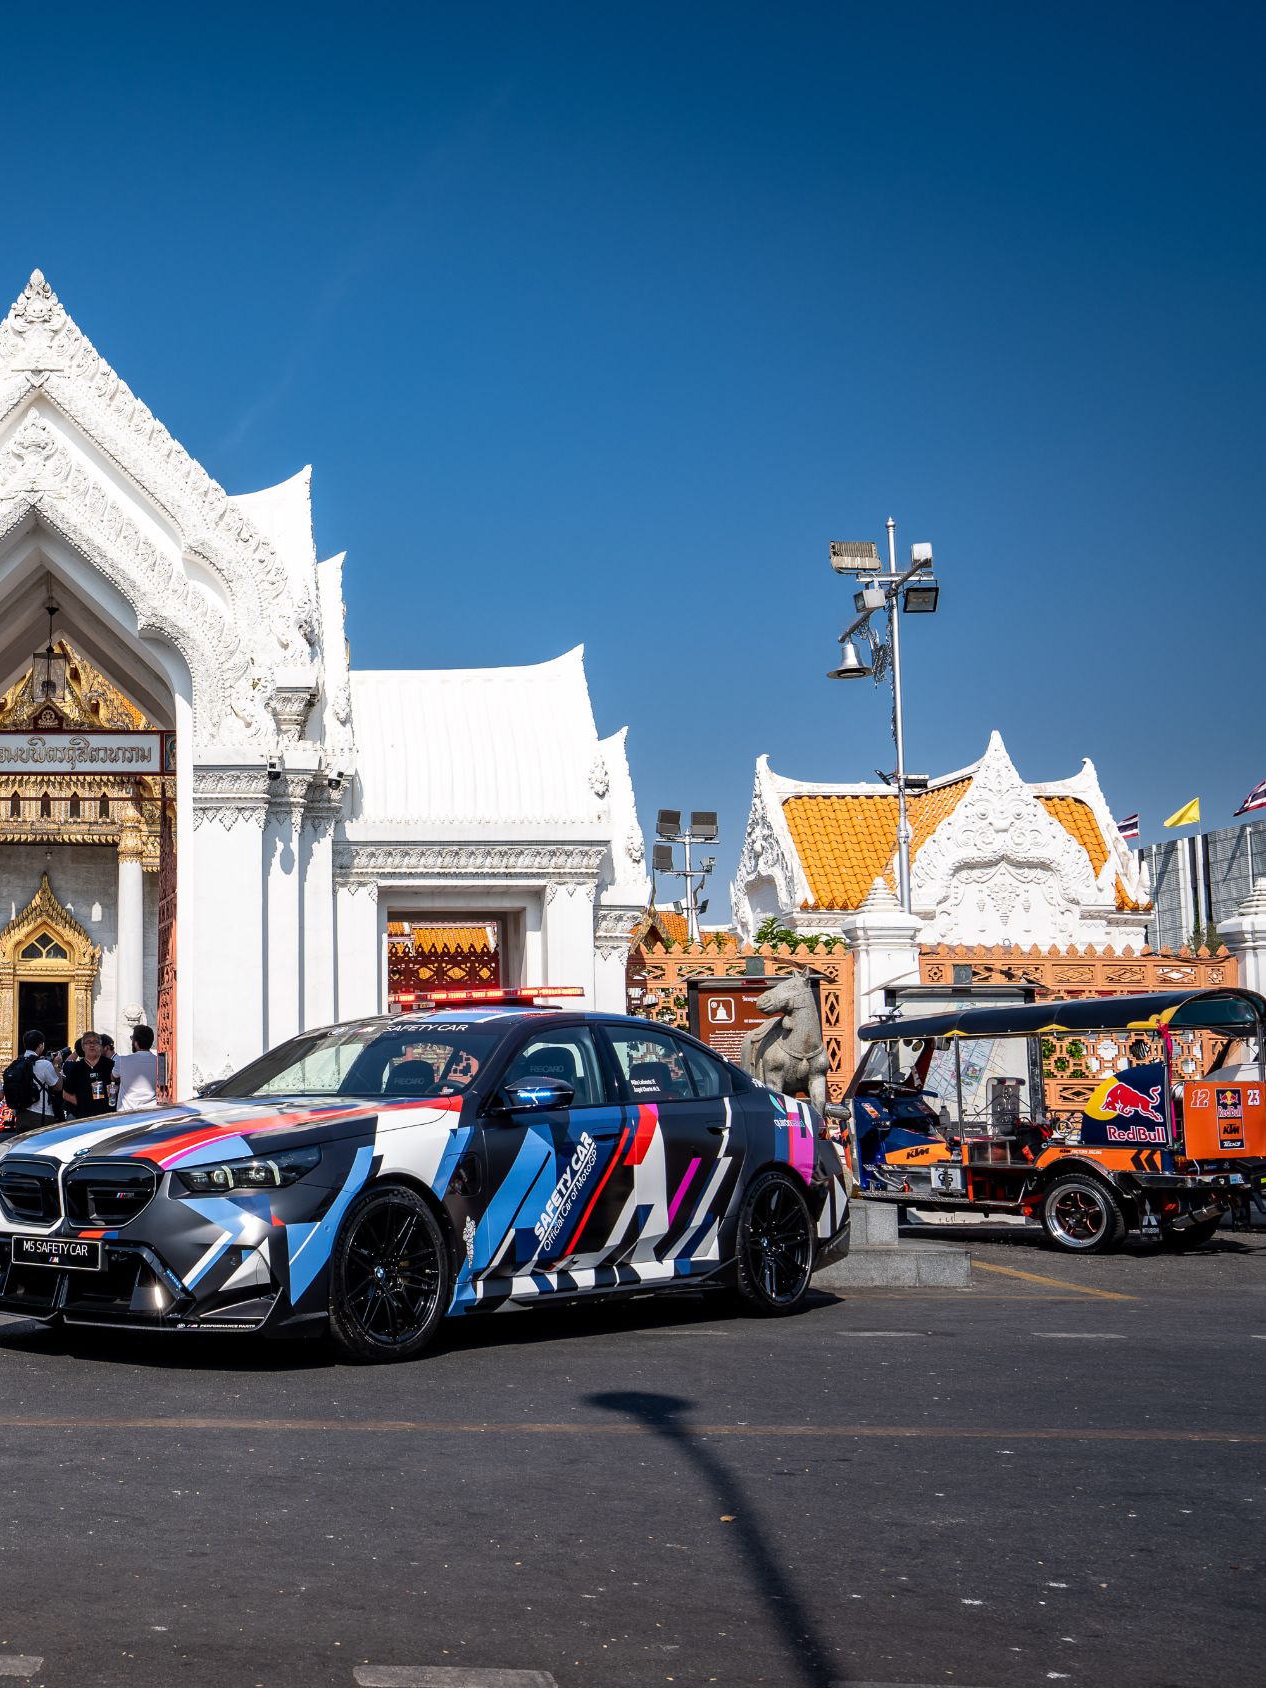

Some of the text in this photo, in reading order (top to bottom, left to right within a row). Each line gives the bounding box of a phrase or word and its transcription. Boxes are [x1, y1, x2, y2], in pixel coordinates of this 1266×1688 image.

[382, 1024, 439, 1032] SAFETY
[530, 1065, 565, 1073] RECARO
[394, 1077, 425, 1085] RECARO
[1190, 1088, 1210, 1108] 12
[1247, 1089, 1260, 1106] 23
[1106, 1125, 1166, 1143] Red Bull
[1223, 1123, 1240, 1134] KTM
[906, 1147, 930, 1160] KTM
[534, 1131, 594, 1241] SAFETY CAR
[543, 1214, 565, 1251] Official
[561, 1198, 573, 1217] Car
[571, 1186, 579, 1199] of
[23, 1240, 88, 1256] M5 SAFETY CAR
